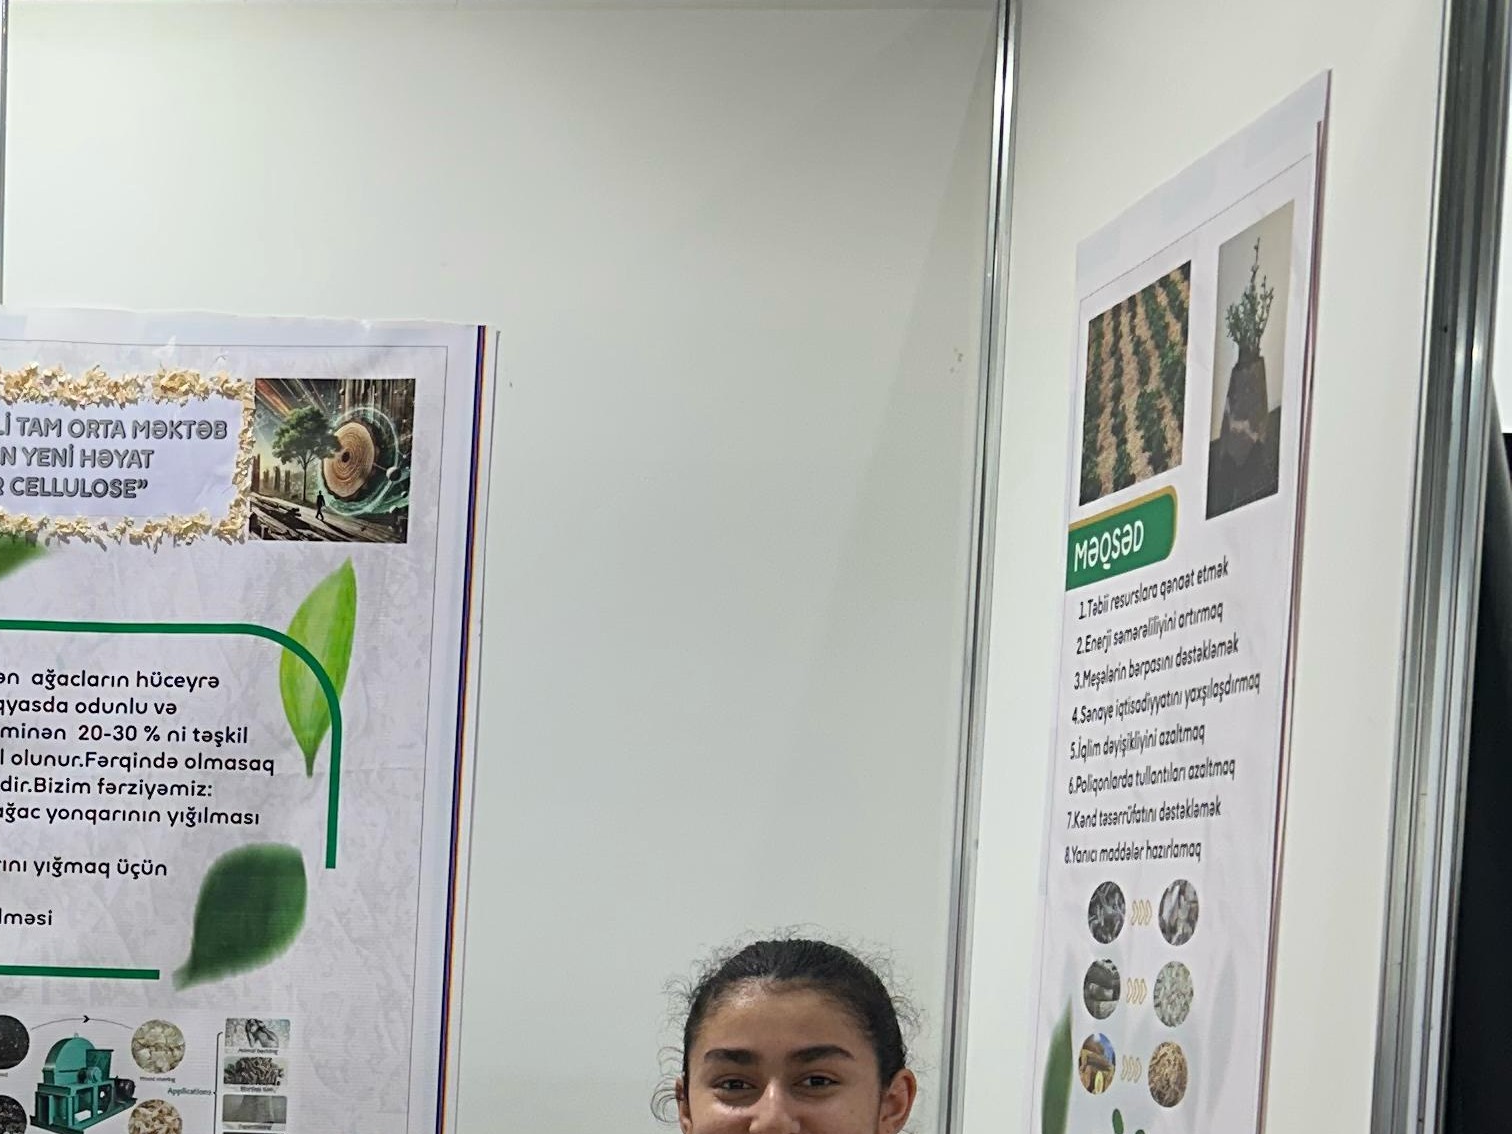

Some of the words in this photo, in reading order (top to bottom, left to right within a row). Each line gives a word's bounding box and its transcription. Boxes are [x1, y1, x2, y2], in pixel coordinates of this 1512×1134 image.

[16, 417, 61, 437] TAM
[68, 419, 125, 439] ORTA
[132, 420, 228, 441] MƏKTƏB
[21, 443, 75, 469] YENİ
[80, 448, 154, 469] HƏYAT
[1074, 520, 1144, 572] MƏQSƏD
[1111, 582, 1157, 611] resurslara
[1160, 572, 1195, 600] qənaət
[1197, 555, 1229, 585] etmək
[1076, 629, 1112, 655] 2.Enerji
[1179, 601, 1224, 628] artırmaq
[1074, 664, 1126, 691] 3.Meşələrin
[1129, 650, 1174, 680] bərpasını
[1176, 632, 1239, 670] dəstəkləmək
[32, 669, 129, 690] ağacların
[137, 670, 220, 693] hüceyrə
[75, 698, 148, 714] odunlu
[154, 702, 178, 715] və
[78, 724, 137, 742] 20-30
[144, 726, 161, 742] %
[167, 726, 186, 743] ni
[192, 727, 249, 748] təşkil
[1159, 723, 1206, 746] azaltmaq
[11, 750, 178, 771] olunur.Fərqində
[184, 752, 275, 776] olmasaq
[1188, 756, 1236, 781] azaltmaq
[97, 778, 212, 800] fərziyəmiz:
[46, 804, 161, 830] yonqarının
[167, 806, 261, 828] yığılması
[1159, 795, 1222, 822] dəstəkləmək
[33, 856, 110, 879] yığmaq
[116, 859, 168, 880] üçün
